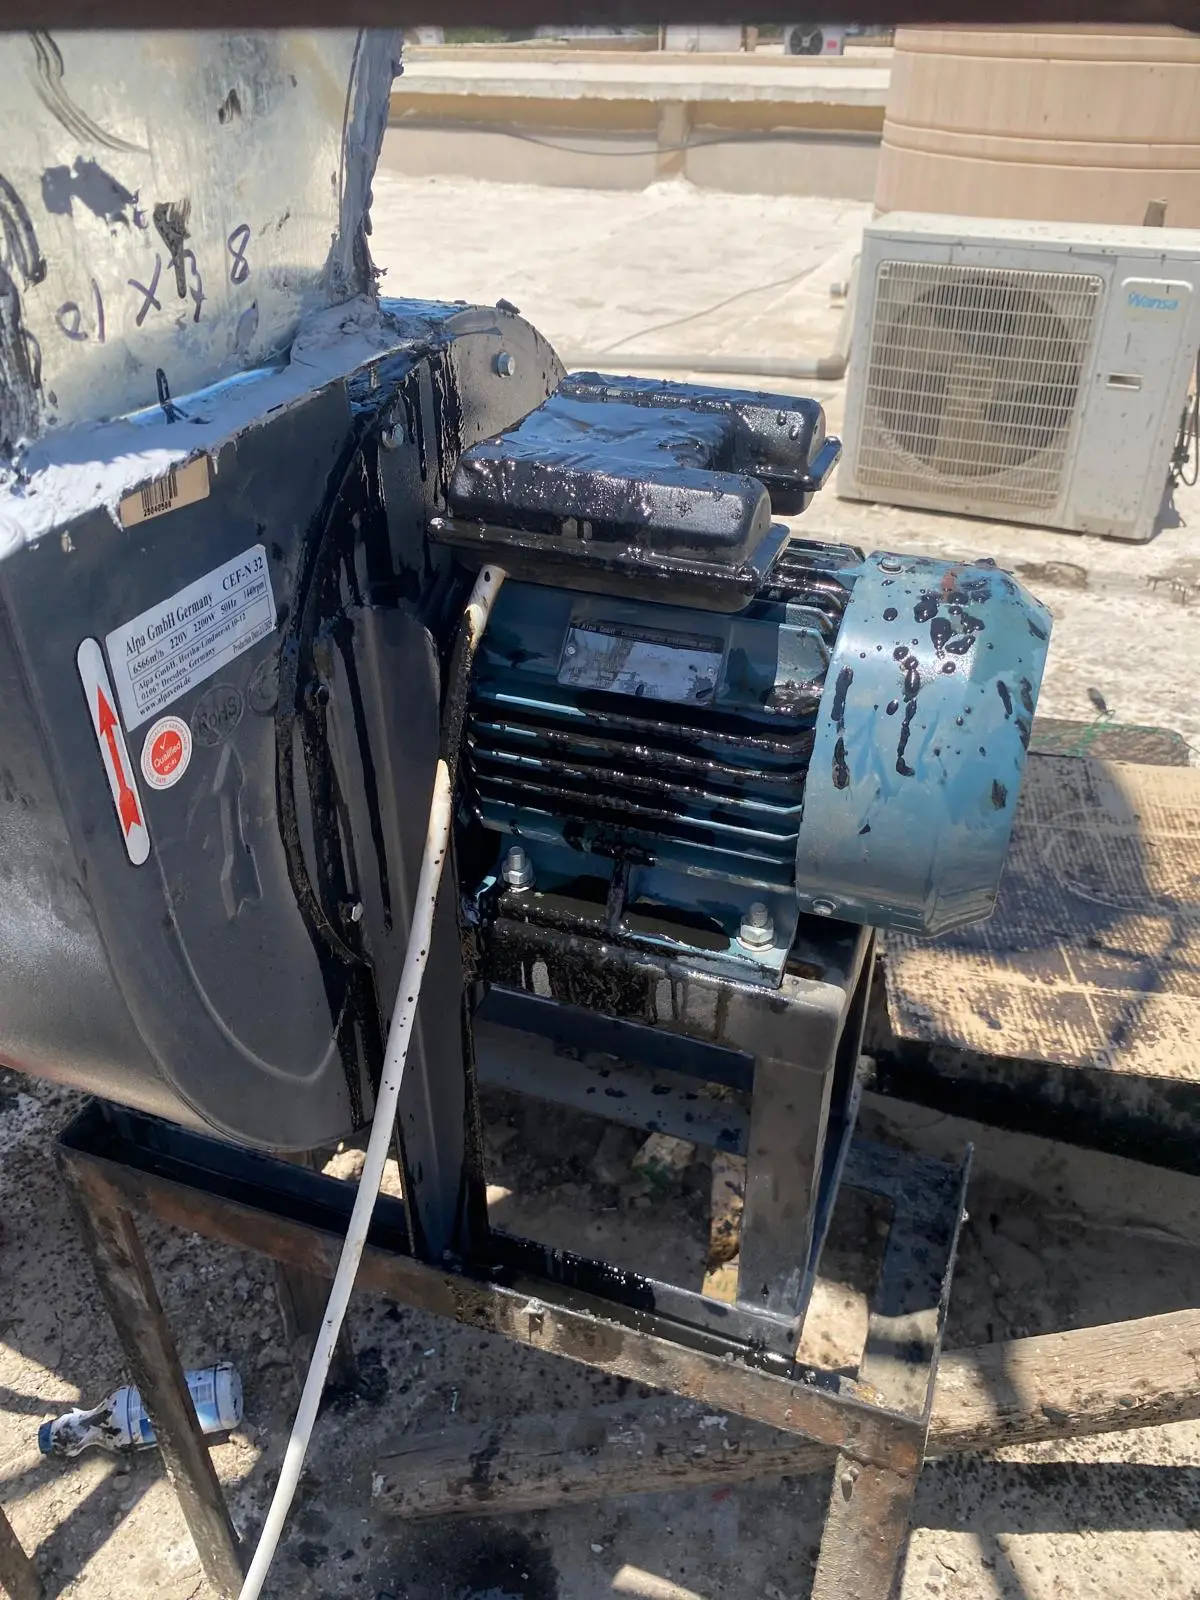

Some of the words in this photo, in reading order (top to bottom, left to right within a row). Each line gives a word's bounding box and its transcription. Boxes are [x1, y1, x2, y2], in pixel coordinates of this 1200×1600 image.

[1127, 291, 1179, 311] Wansa
[125, 634, 147, 656] Alpa
[147, 612, 176, 641] GmbH
[176, 592, 213, 622] Germany
[169, 630, 190, 650] 220V
[193, 612, 217, 632] 2200W
[220, 599, 238, 616] 50Hz
[188, 648, 217, 669] Germany
[138, 674, 154, 692] Alpa
[153, 739, 182, 769] Qualified
